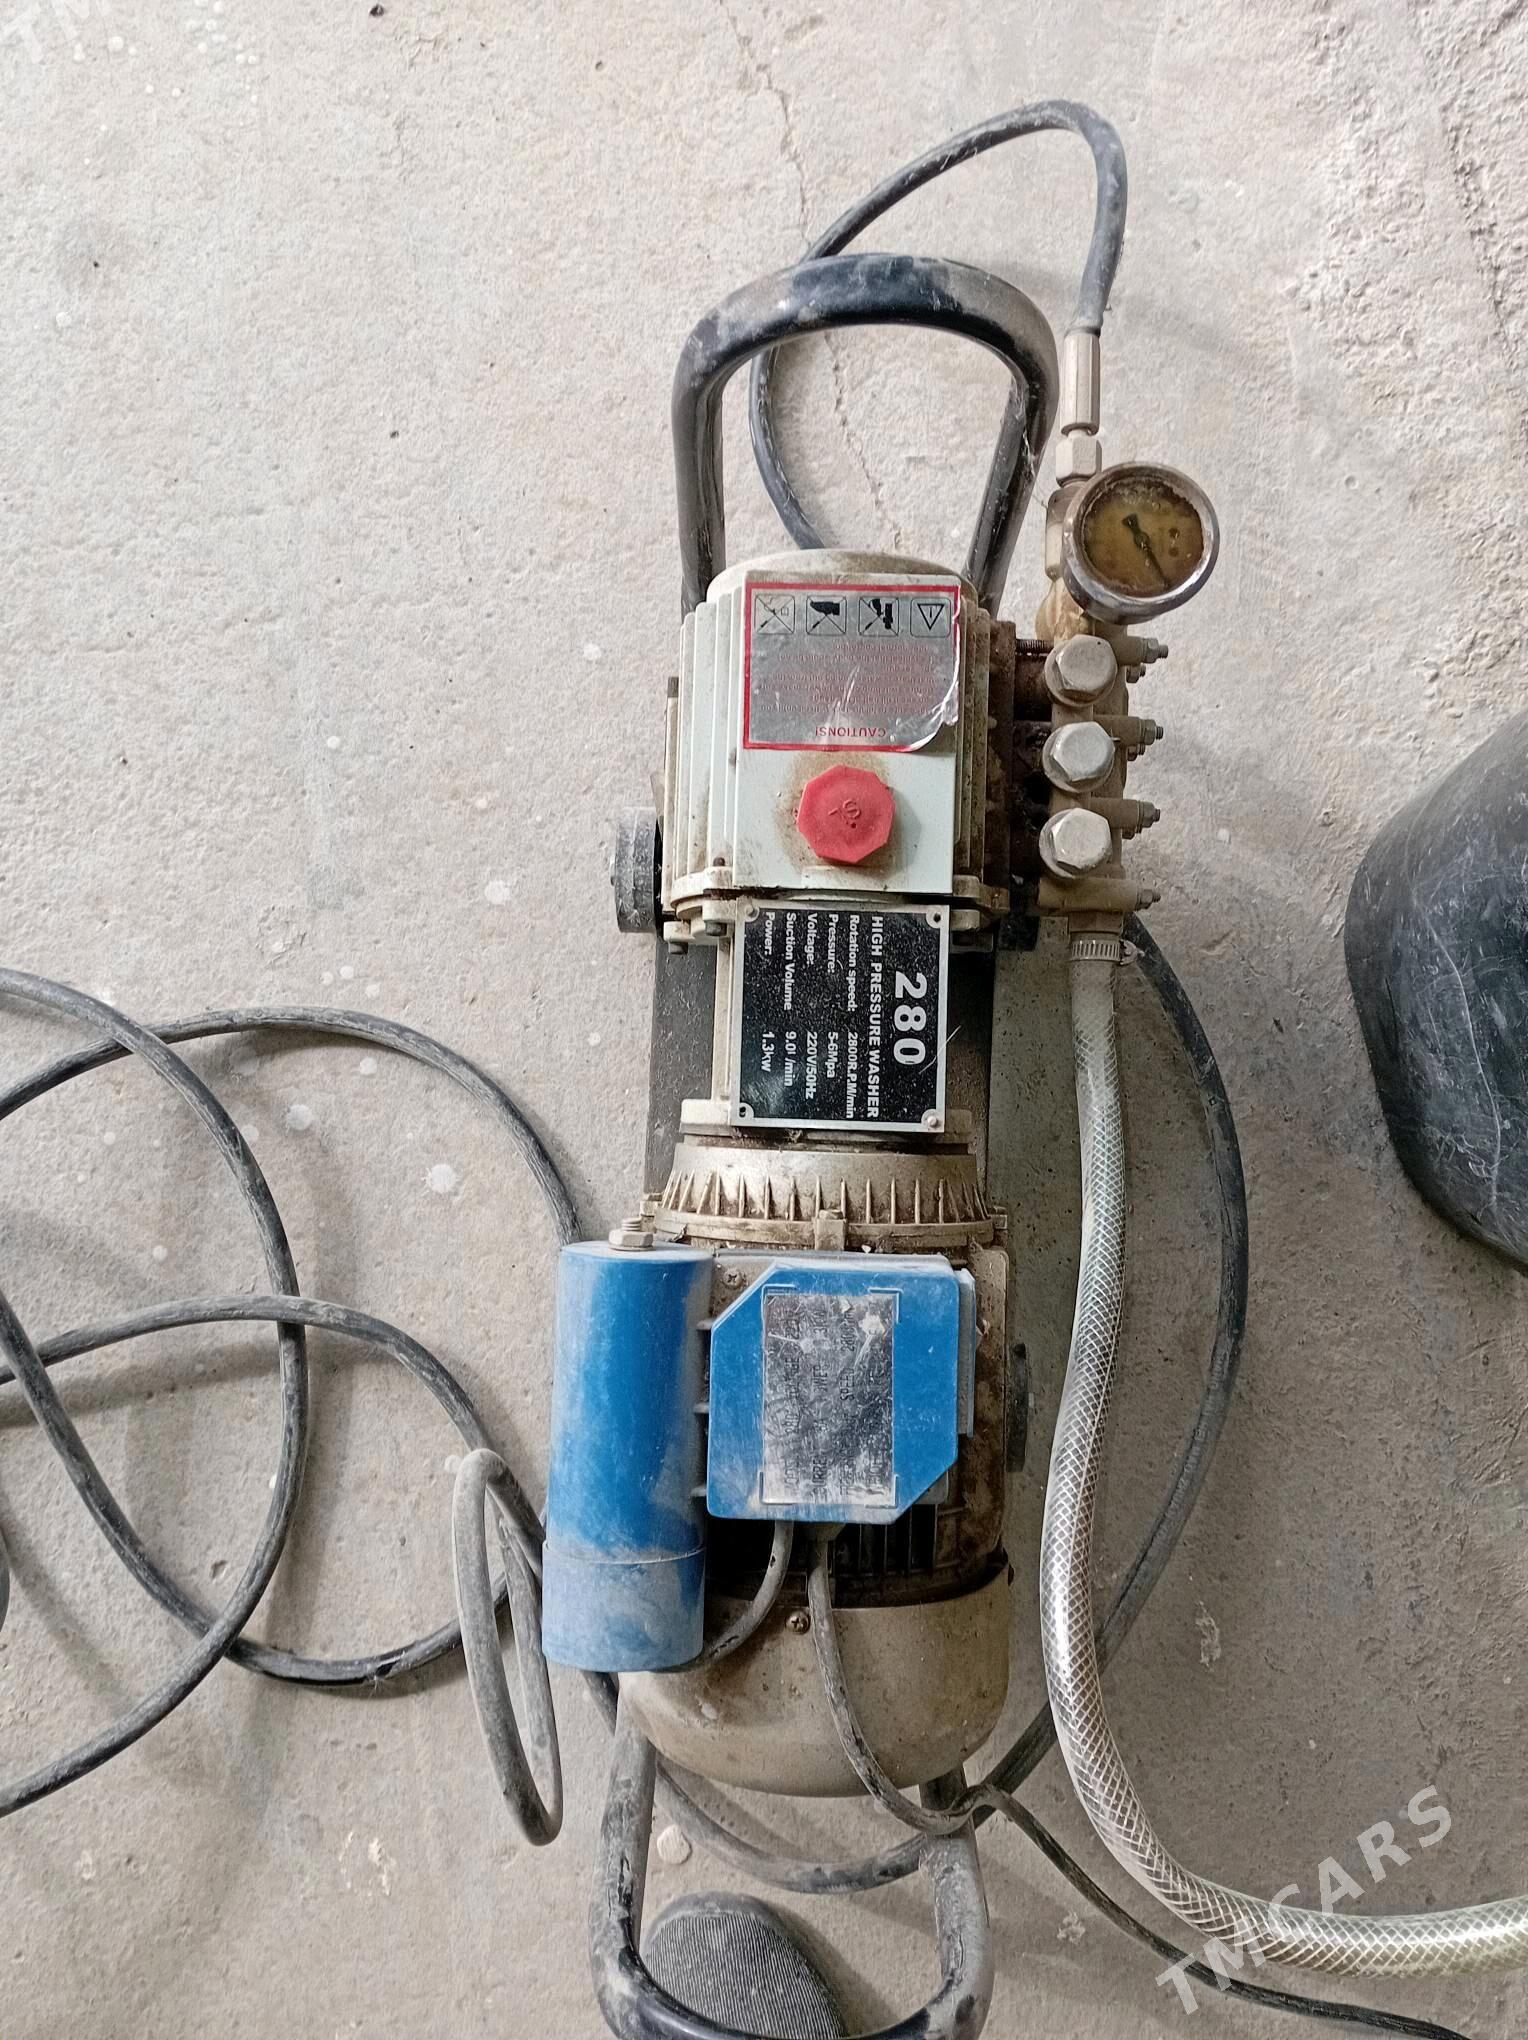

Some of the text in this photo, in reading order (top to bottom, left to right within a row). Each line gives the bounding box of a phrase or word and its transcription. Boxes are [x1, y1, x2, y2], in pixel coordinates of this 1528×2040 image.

[815, 726, 887, 737] CAUTIONS!
[785, 912, 797, 960] Suction
[848, 914, 861, 967] Rotation
[761, 911, 776, 1072] Power: 1.3kw
[783, 962, 796, 1011] Volume
[804, 912, 818, 1100] Voltage: 220V/50Hz
[826, 913, 839, 1079] Pressure: 5-6Mpa
[846, 970, 859, 1012] speed:
[867, 916, 883, 1118] HIGH PRESSURE WASHER
[893, 971, 928, 1065] 280
